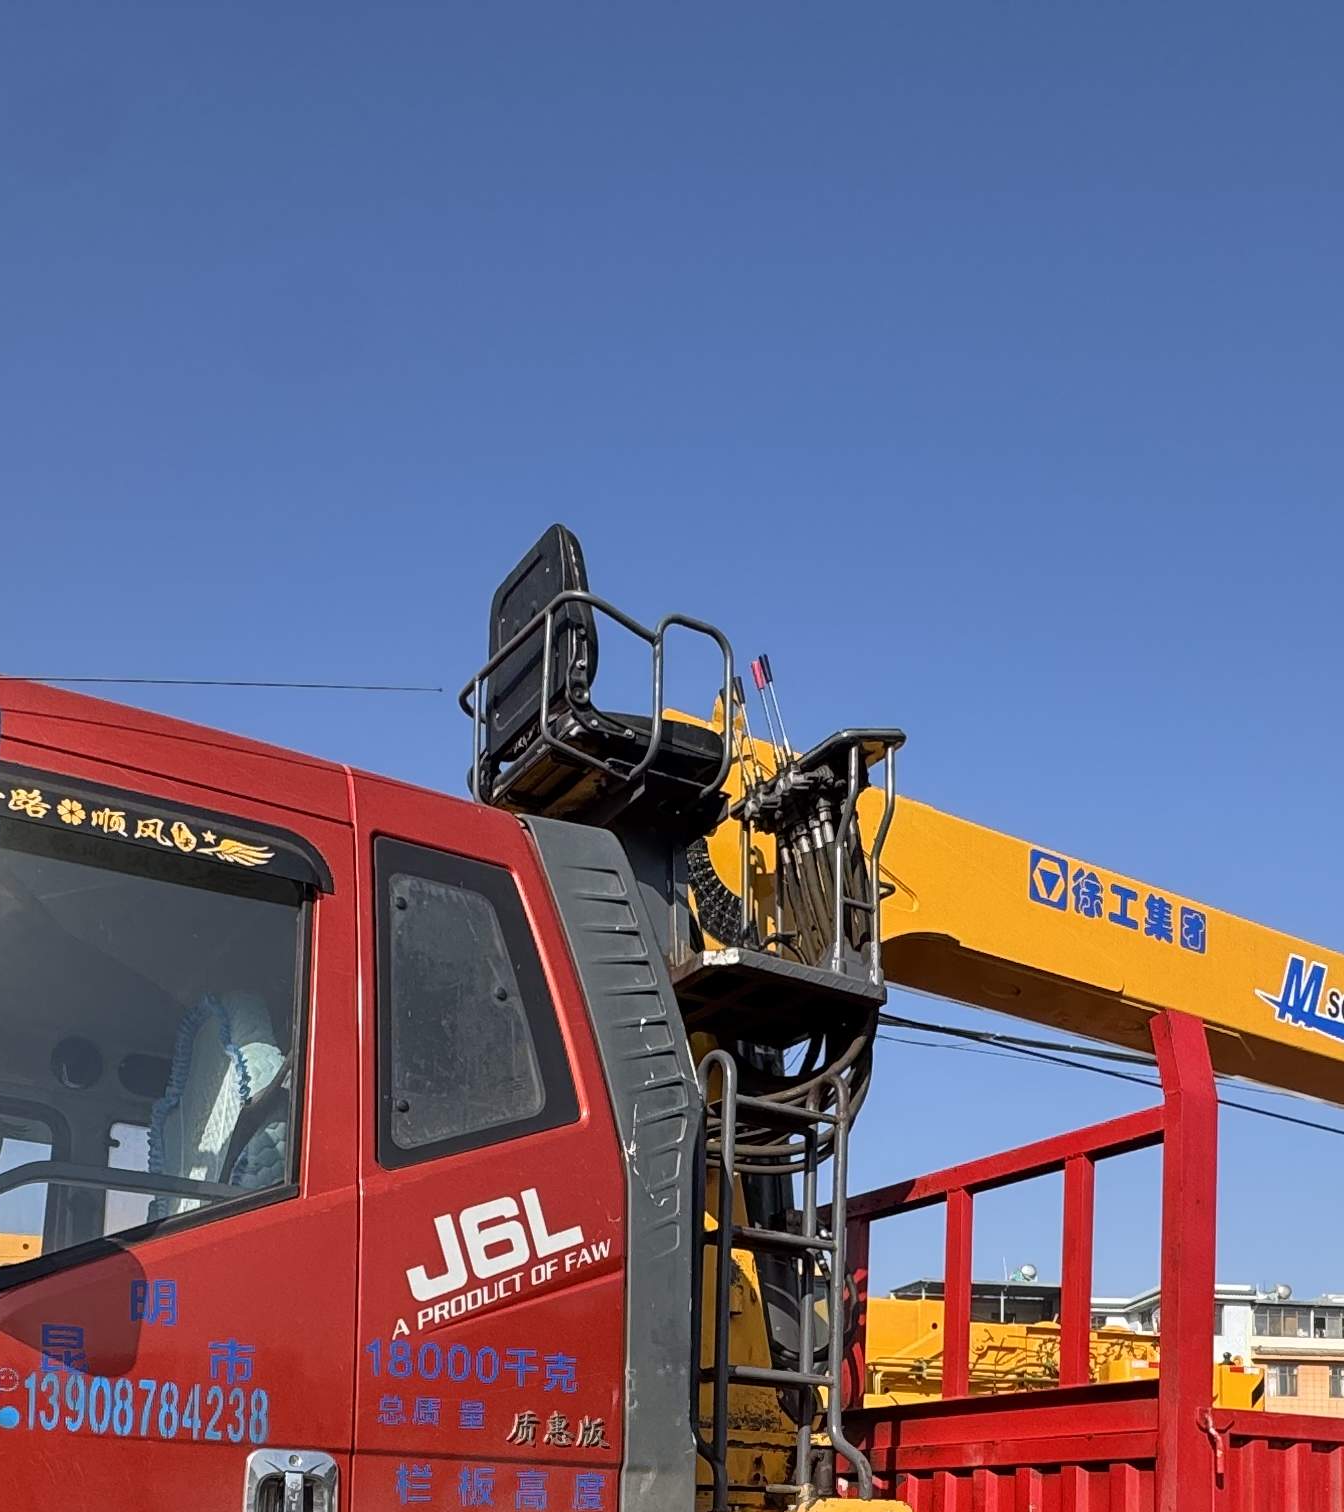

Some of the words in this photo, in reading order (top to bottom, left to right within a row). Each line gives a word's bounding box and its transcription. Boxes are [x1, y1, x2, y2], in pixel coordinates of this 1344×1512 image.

[1072, 867, 1206, 954] 徐工集团
[406, 1188, 584, 1302] J6L
[392, 1318, 410, 1340] A
[417, 1272, 524, 1330] PRODUCT
[530, 1258, 558, 1286] OF
[565, 1238, 611, 1272] FAW
[366, 1338, 579, 1393] 18000千克
[24, 1371, 269, 1445] 13908784238
[395, 1463, 606, 1512] 栏板高度
